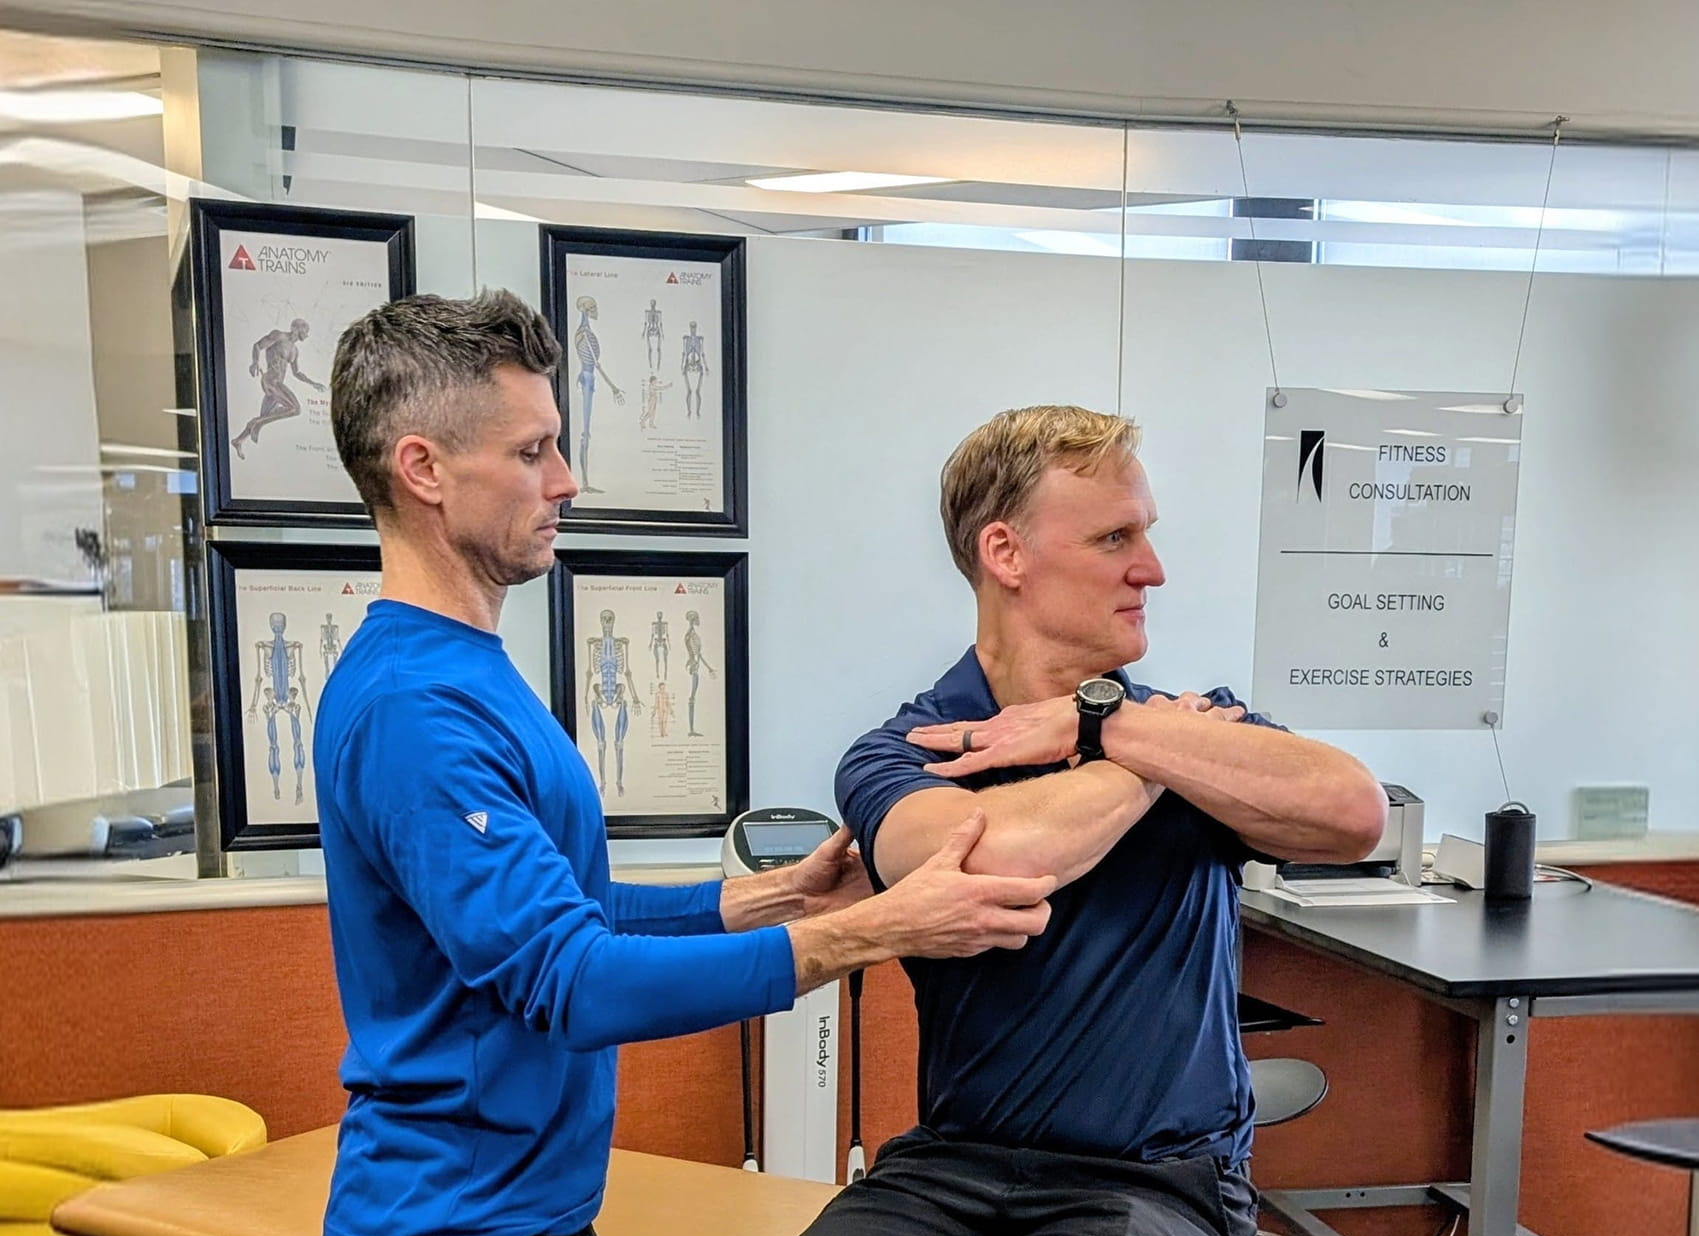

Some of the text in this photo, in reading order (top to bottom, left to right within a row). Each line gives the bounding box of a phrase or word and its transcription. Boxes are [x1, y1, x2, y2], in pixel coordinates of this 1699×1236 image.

[258, 246, 329, 263] ANATOMY
[258, 259, 306, 275] TRAINS
[1379, 445, 1446, 463] FITNESS
[1349, 483, 1471, 501] CONSULTATION
[249, 584, 286, 592] Superficial
[590, 584, 624, 592] Superficial
[1328, 593, 1445, 612] GOAL SETTING
[1379, 631, 1389, 648] &
[1289, 668, 1473, 687] EXERCISE STRATEGIES
[816, 1015, 830, 1088] InBody 570
